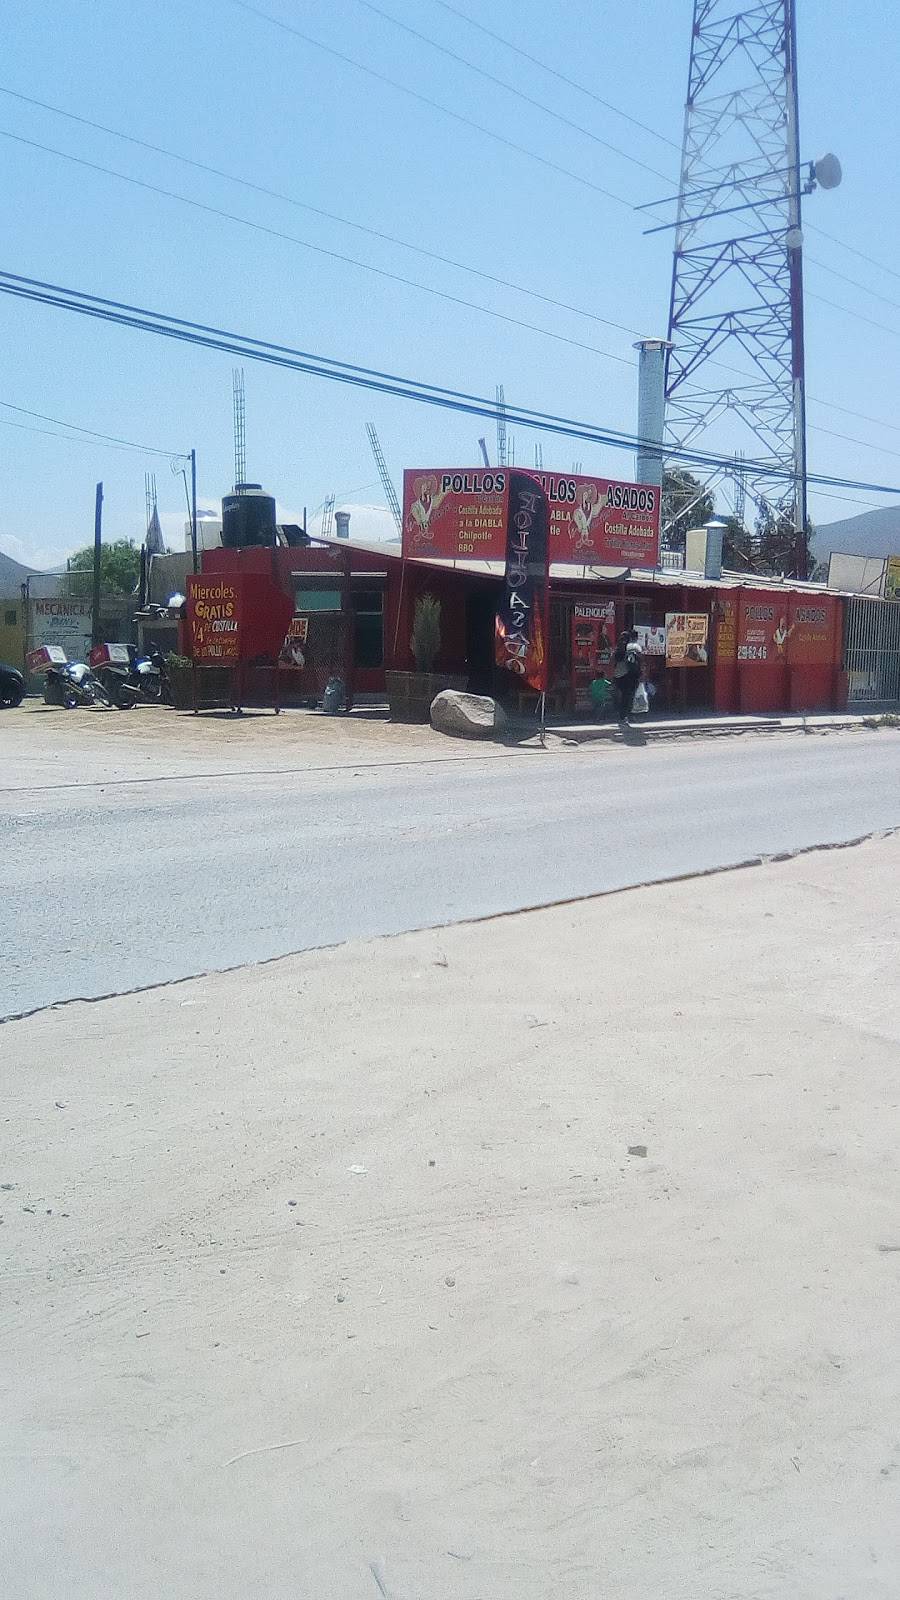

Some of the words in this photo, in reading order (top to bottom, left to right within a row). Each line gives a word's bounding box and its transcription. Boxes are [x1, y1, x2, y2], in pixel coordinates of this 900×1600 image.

[441, 474, 506, 495] POLLOS
[605, 485, 655, 513] ASADOS
[458, 505, 478, 515] Costilla
[550, 510, 571, 521] ABLA
[474, 519, 503, 528] DIABLA
[604, 521, 628, 536] Costilla
[628, 524, 654, 537] Adobada
[458, 530, 492, 542] Chilpotle
[458, 543, 474, 553] BBQ
[195, 600, 234, 620] GRATIS
[574, 605, 607, 618] PALENQUE
[211, 620, 238, 633] COSTILLA
